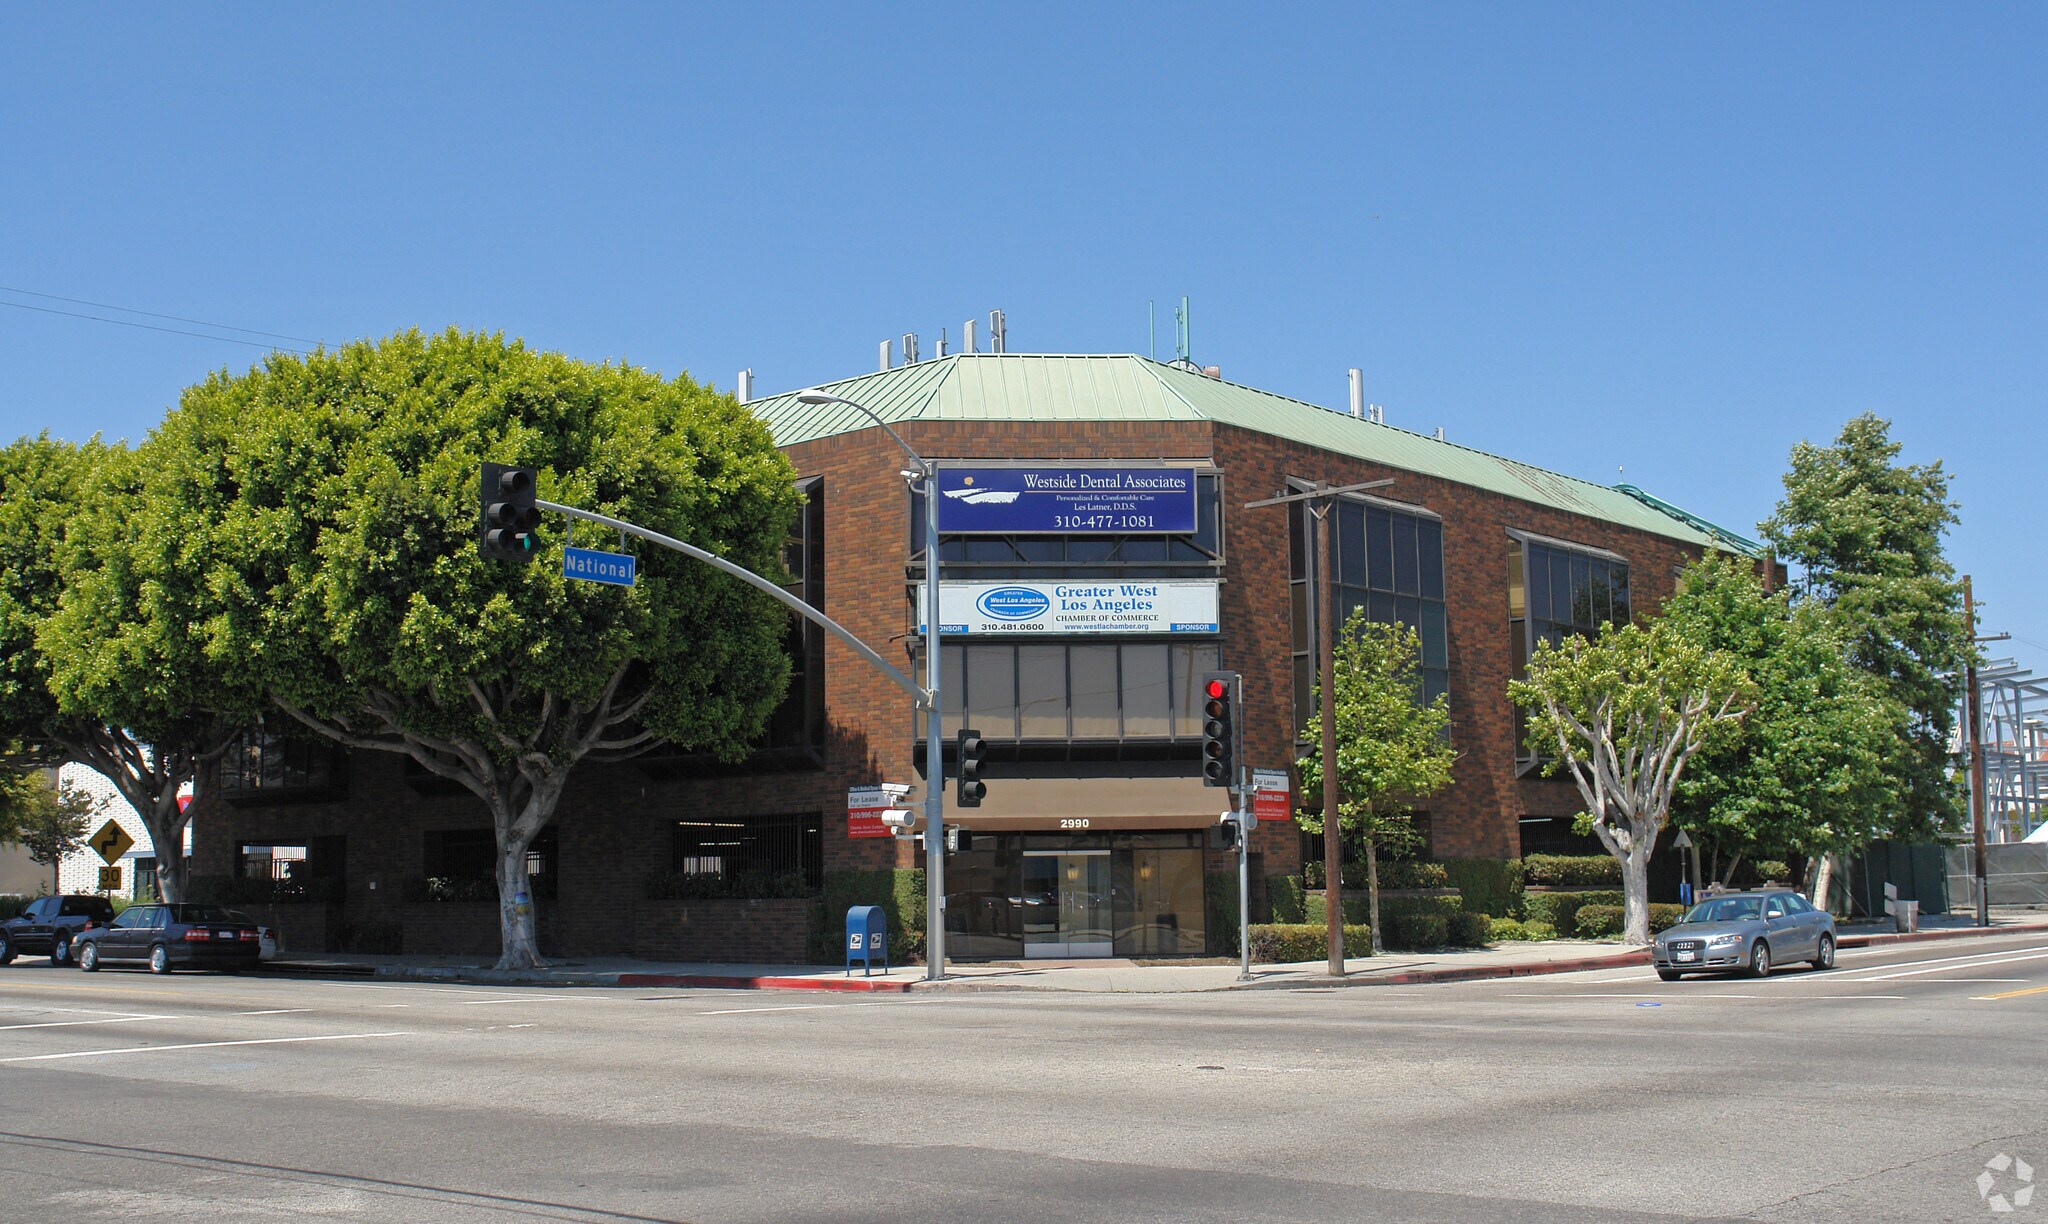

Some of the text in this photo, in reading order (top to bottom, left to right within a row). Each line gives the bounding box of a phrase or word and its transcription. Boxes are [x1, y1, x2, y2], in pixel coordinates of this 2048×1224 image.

[1024, 474, 1186, 488] Westside Dental Associates
[1074, 503, 1137, 512] Les Latner, D.D.S.
[1054, 515, 1154, 528] 310-477-1081
[566, 554, 632, 578] National
[1055, 585, 1158, 597] Greater West
[1061, 598, 1153, 613] Los Angeles
[981, 623, 1044, 631] 310.481.0600
[1064, 622, 1149, 630] www.westlachamber.org
[1060, 819, 1089, 828] 2990
[102, 869, 119, 882] 30
